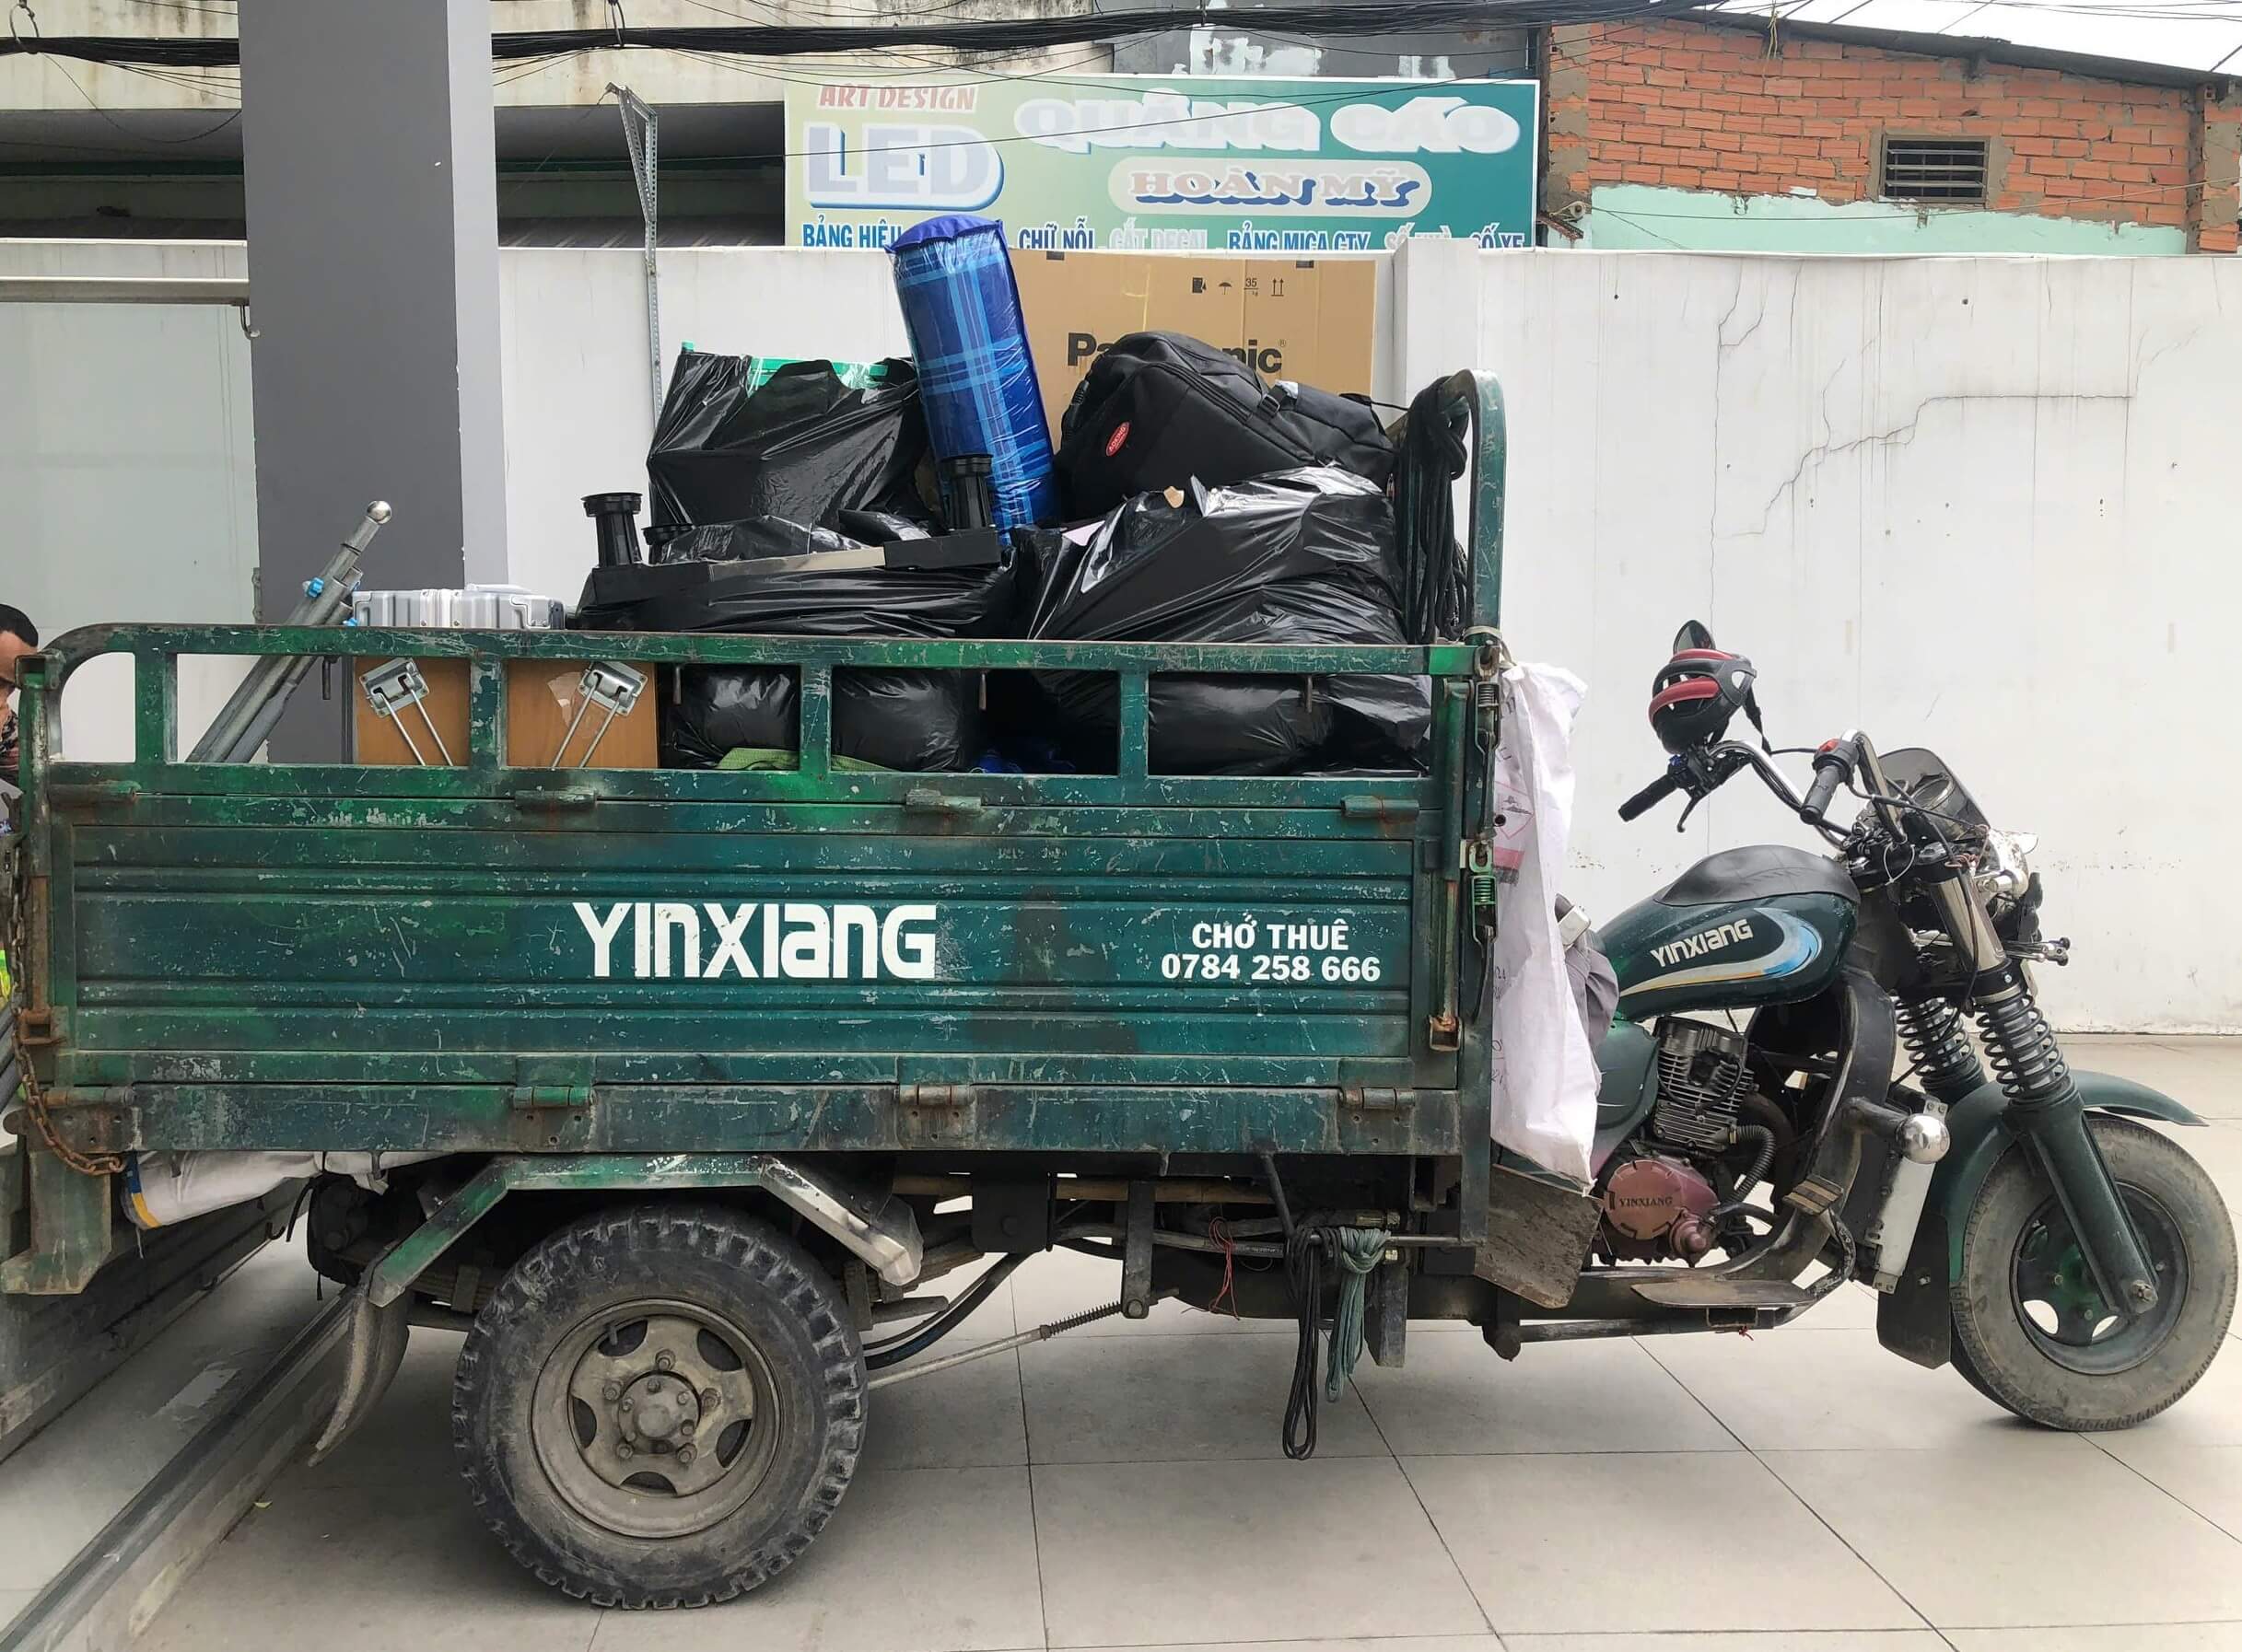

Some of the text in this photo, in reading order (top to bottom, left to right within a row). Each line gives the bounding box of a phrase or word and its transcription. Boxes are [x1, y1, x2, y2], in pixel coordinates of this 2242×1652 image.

[819, 85, 976, 112] ART DESIGN
[804, 122, 1002, 206] LED
[1129, 166, 1419, 205] HOÀN MỸ
[802, 214, 853, 248] BẢNG
[1018, 222, 1058, 250] CHỮ
[1227, 220, 1279, 250] BẢNG
[1191, 913, 1349, 950] CHỞ THUÊ
[1161, 953, 1381, 983] 0784 258 666
[1619, 1196, 1673, 1207] YINXIANG
